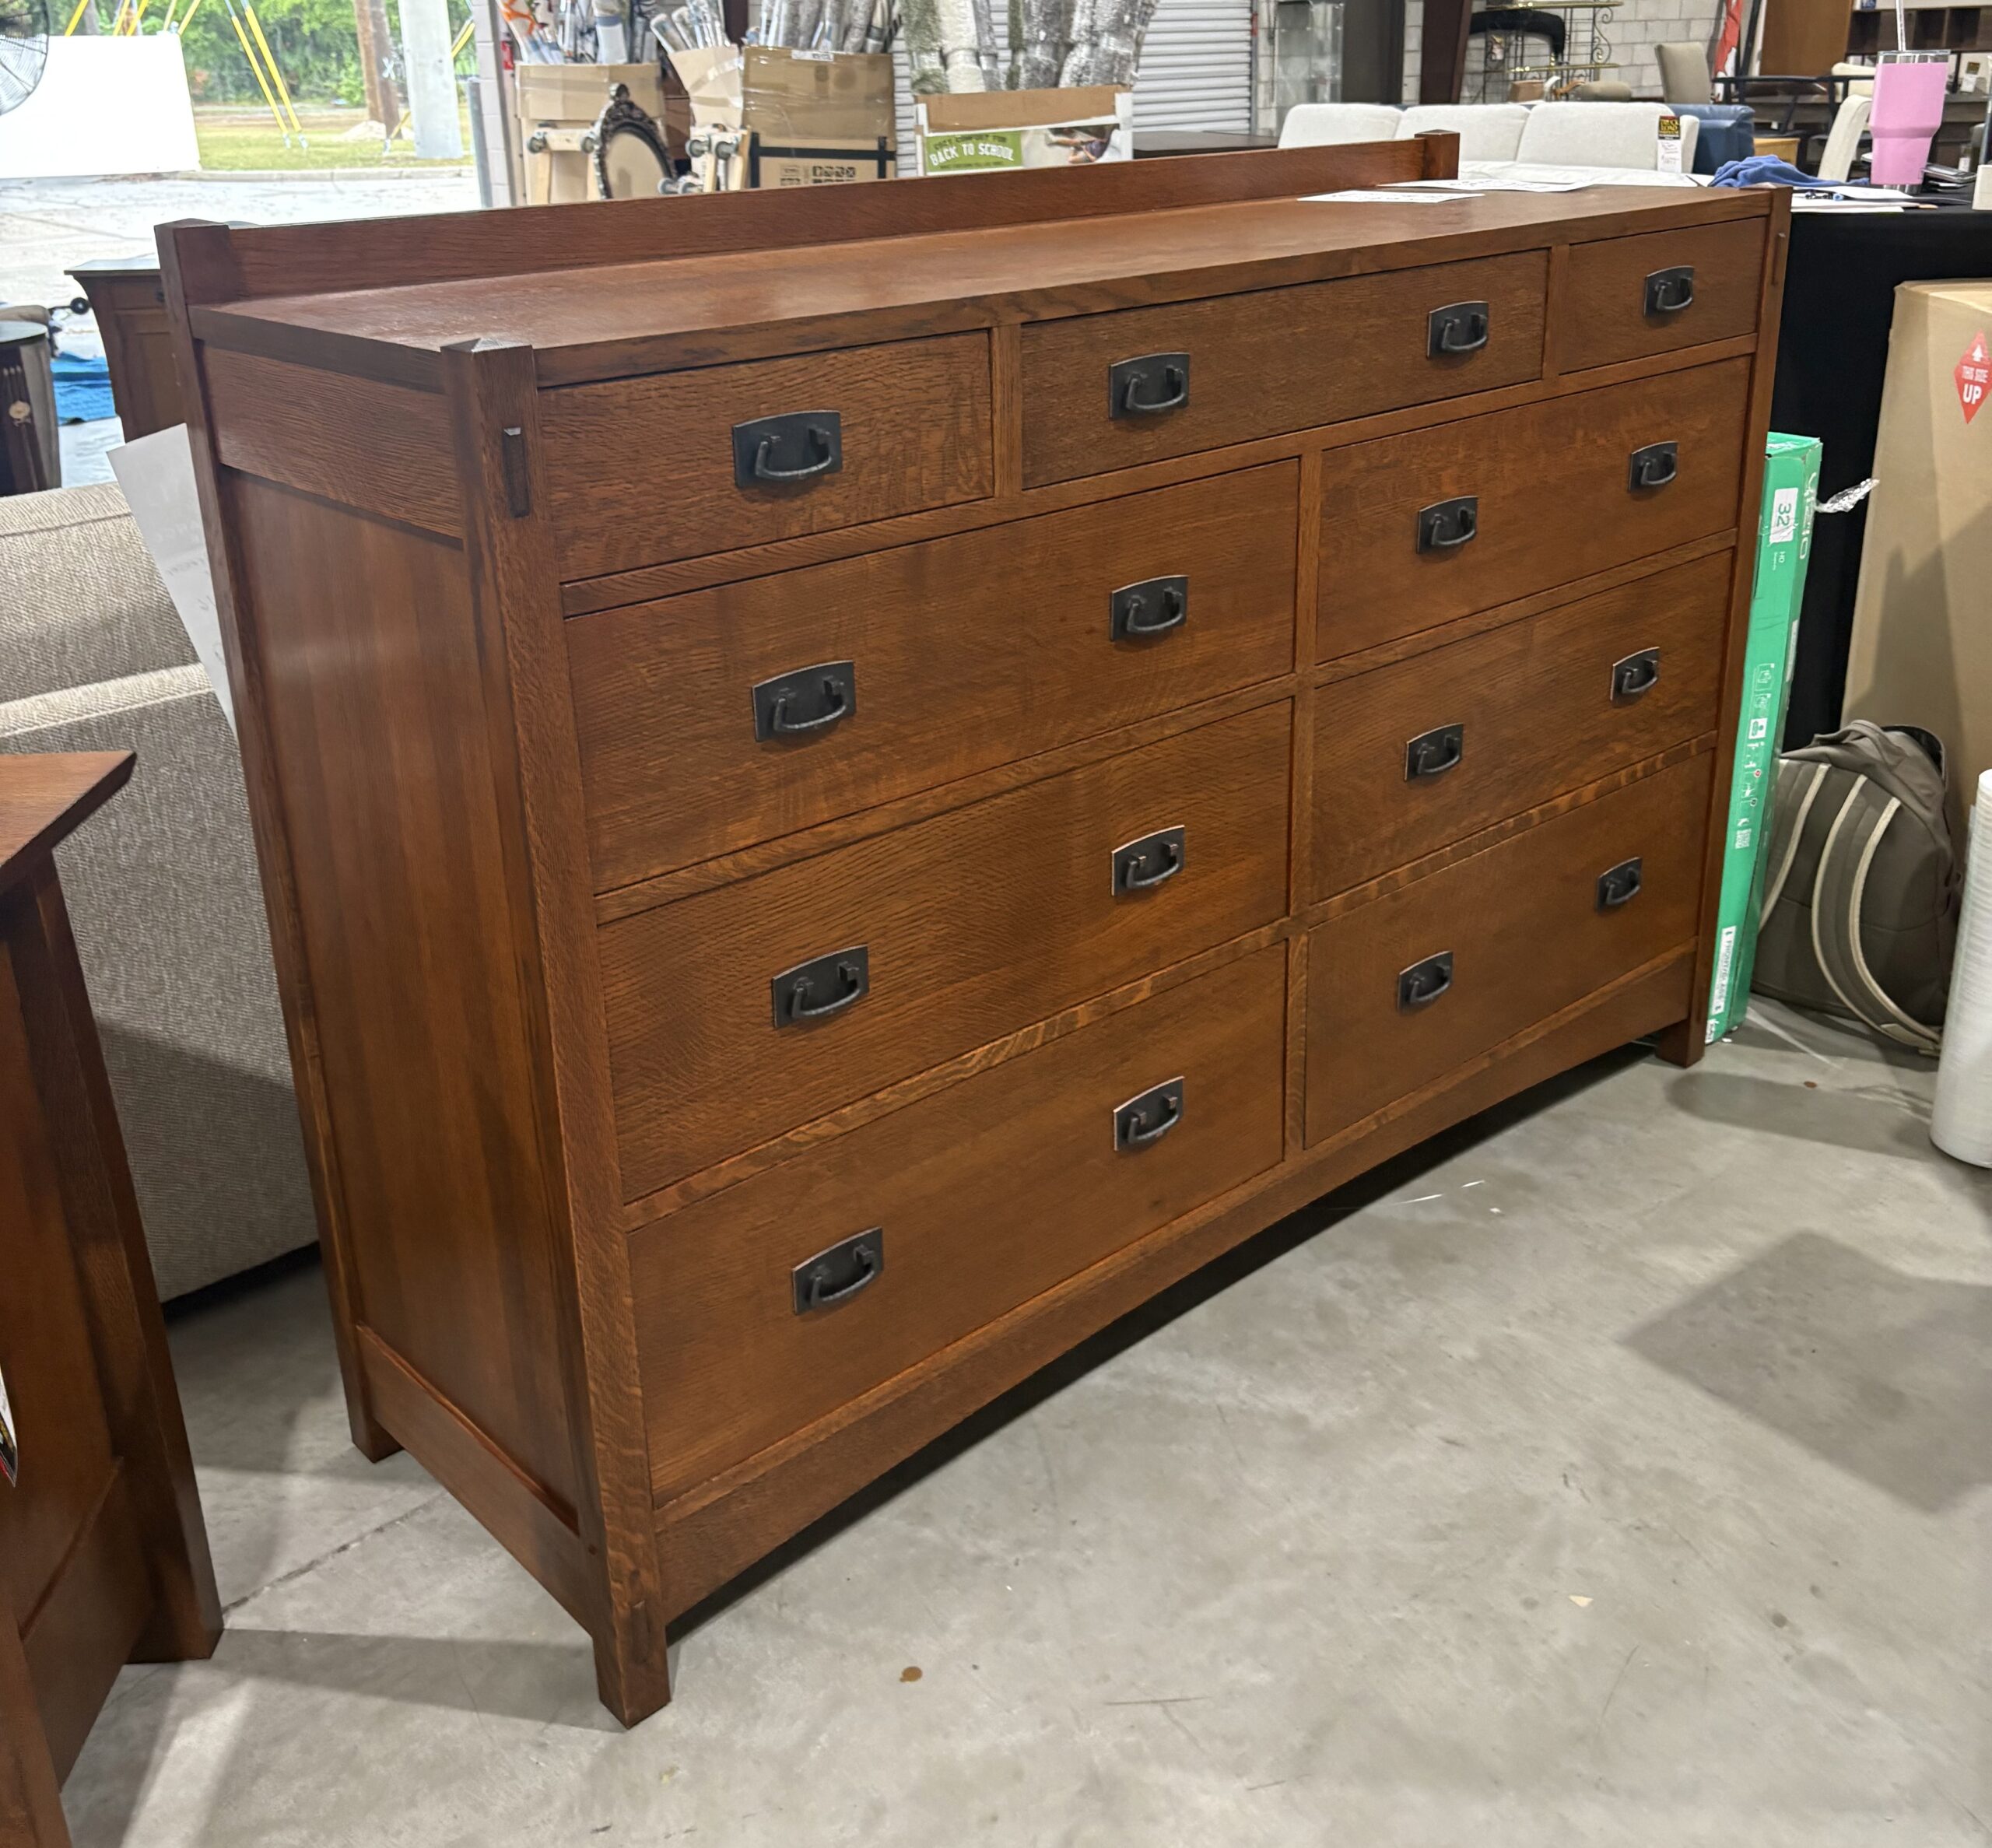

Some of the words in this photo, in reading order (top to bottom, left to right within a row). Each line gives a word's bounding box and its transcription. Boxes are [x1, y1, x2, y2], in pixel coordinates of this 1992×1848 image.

[929, 146, 959, 167] BACK
[961, 143, 975, 156] TO
[978, 142, 1015, 161] SCHOOL
[1963, 384, 1982, 404] UP
[1776, 503, 1792, 528] 32
